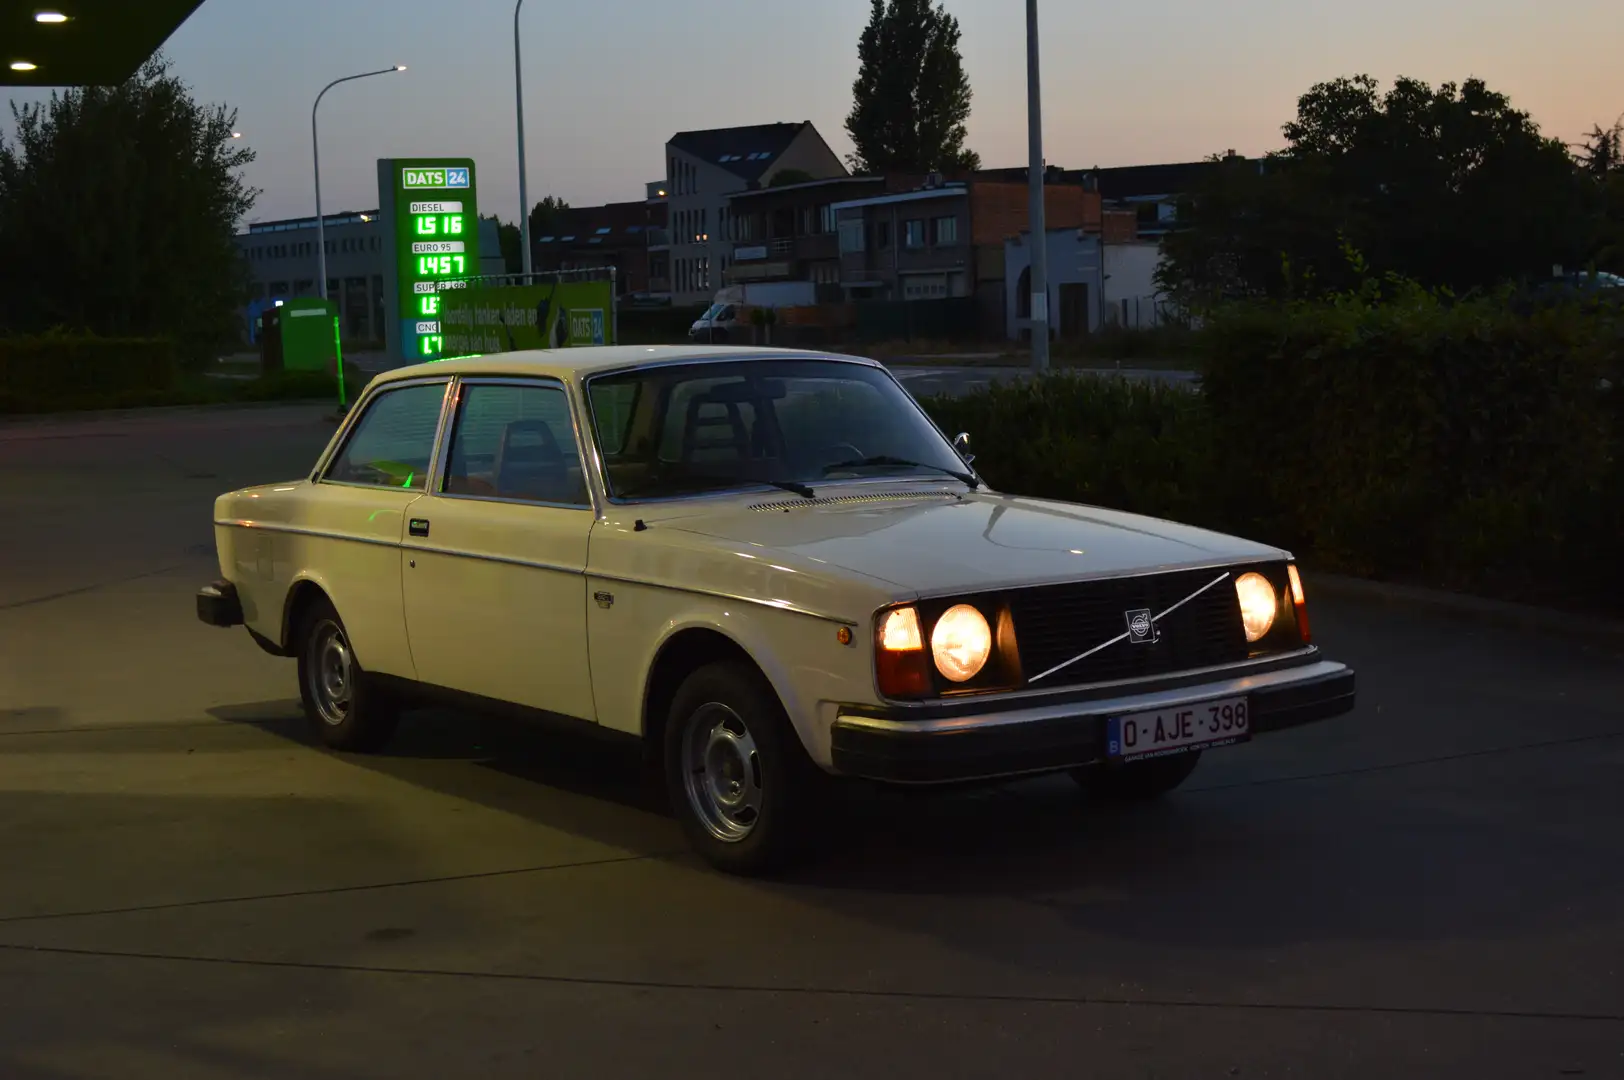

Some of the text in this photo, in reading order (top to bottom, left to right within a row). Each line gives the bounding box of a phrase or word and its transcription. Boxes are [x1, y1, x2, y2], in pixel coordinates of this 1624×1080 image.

[406, 171, 466, 185] DATS 24
[412, 204, 444, 212] DIESEL
[414, 243, 451, 252] EURO 95
[572, 317, 603, 338] DATS 24
[1109, 740, 1119, 753] B
